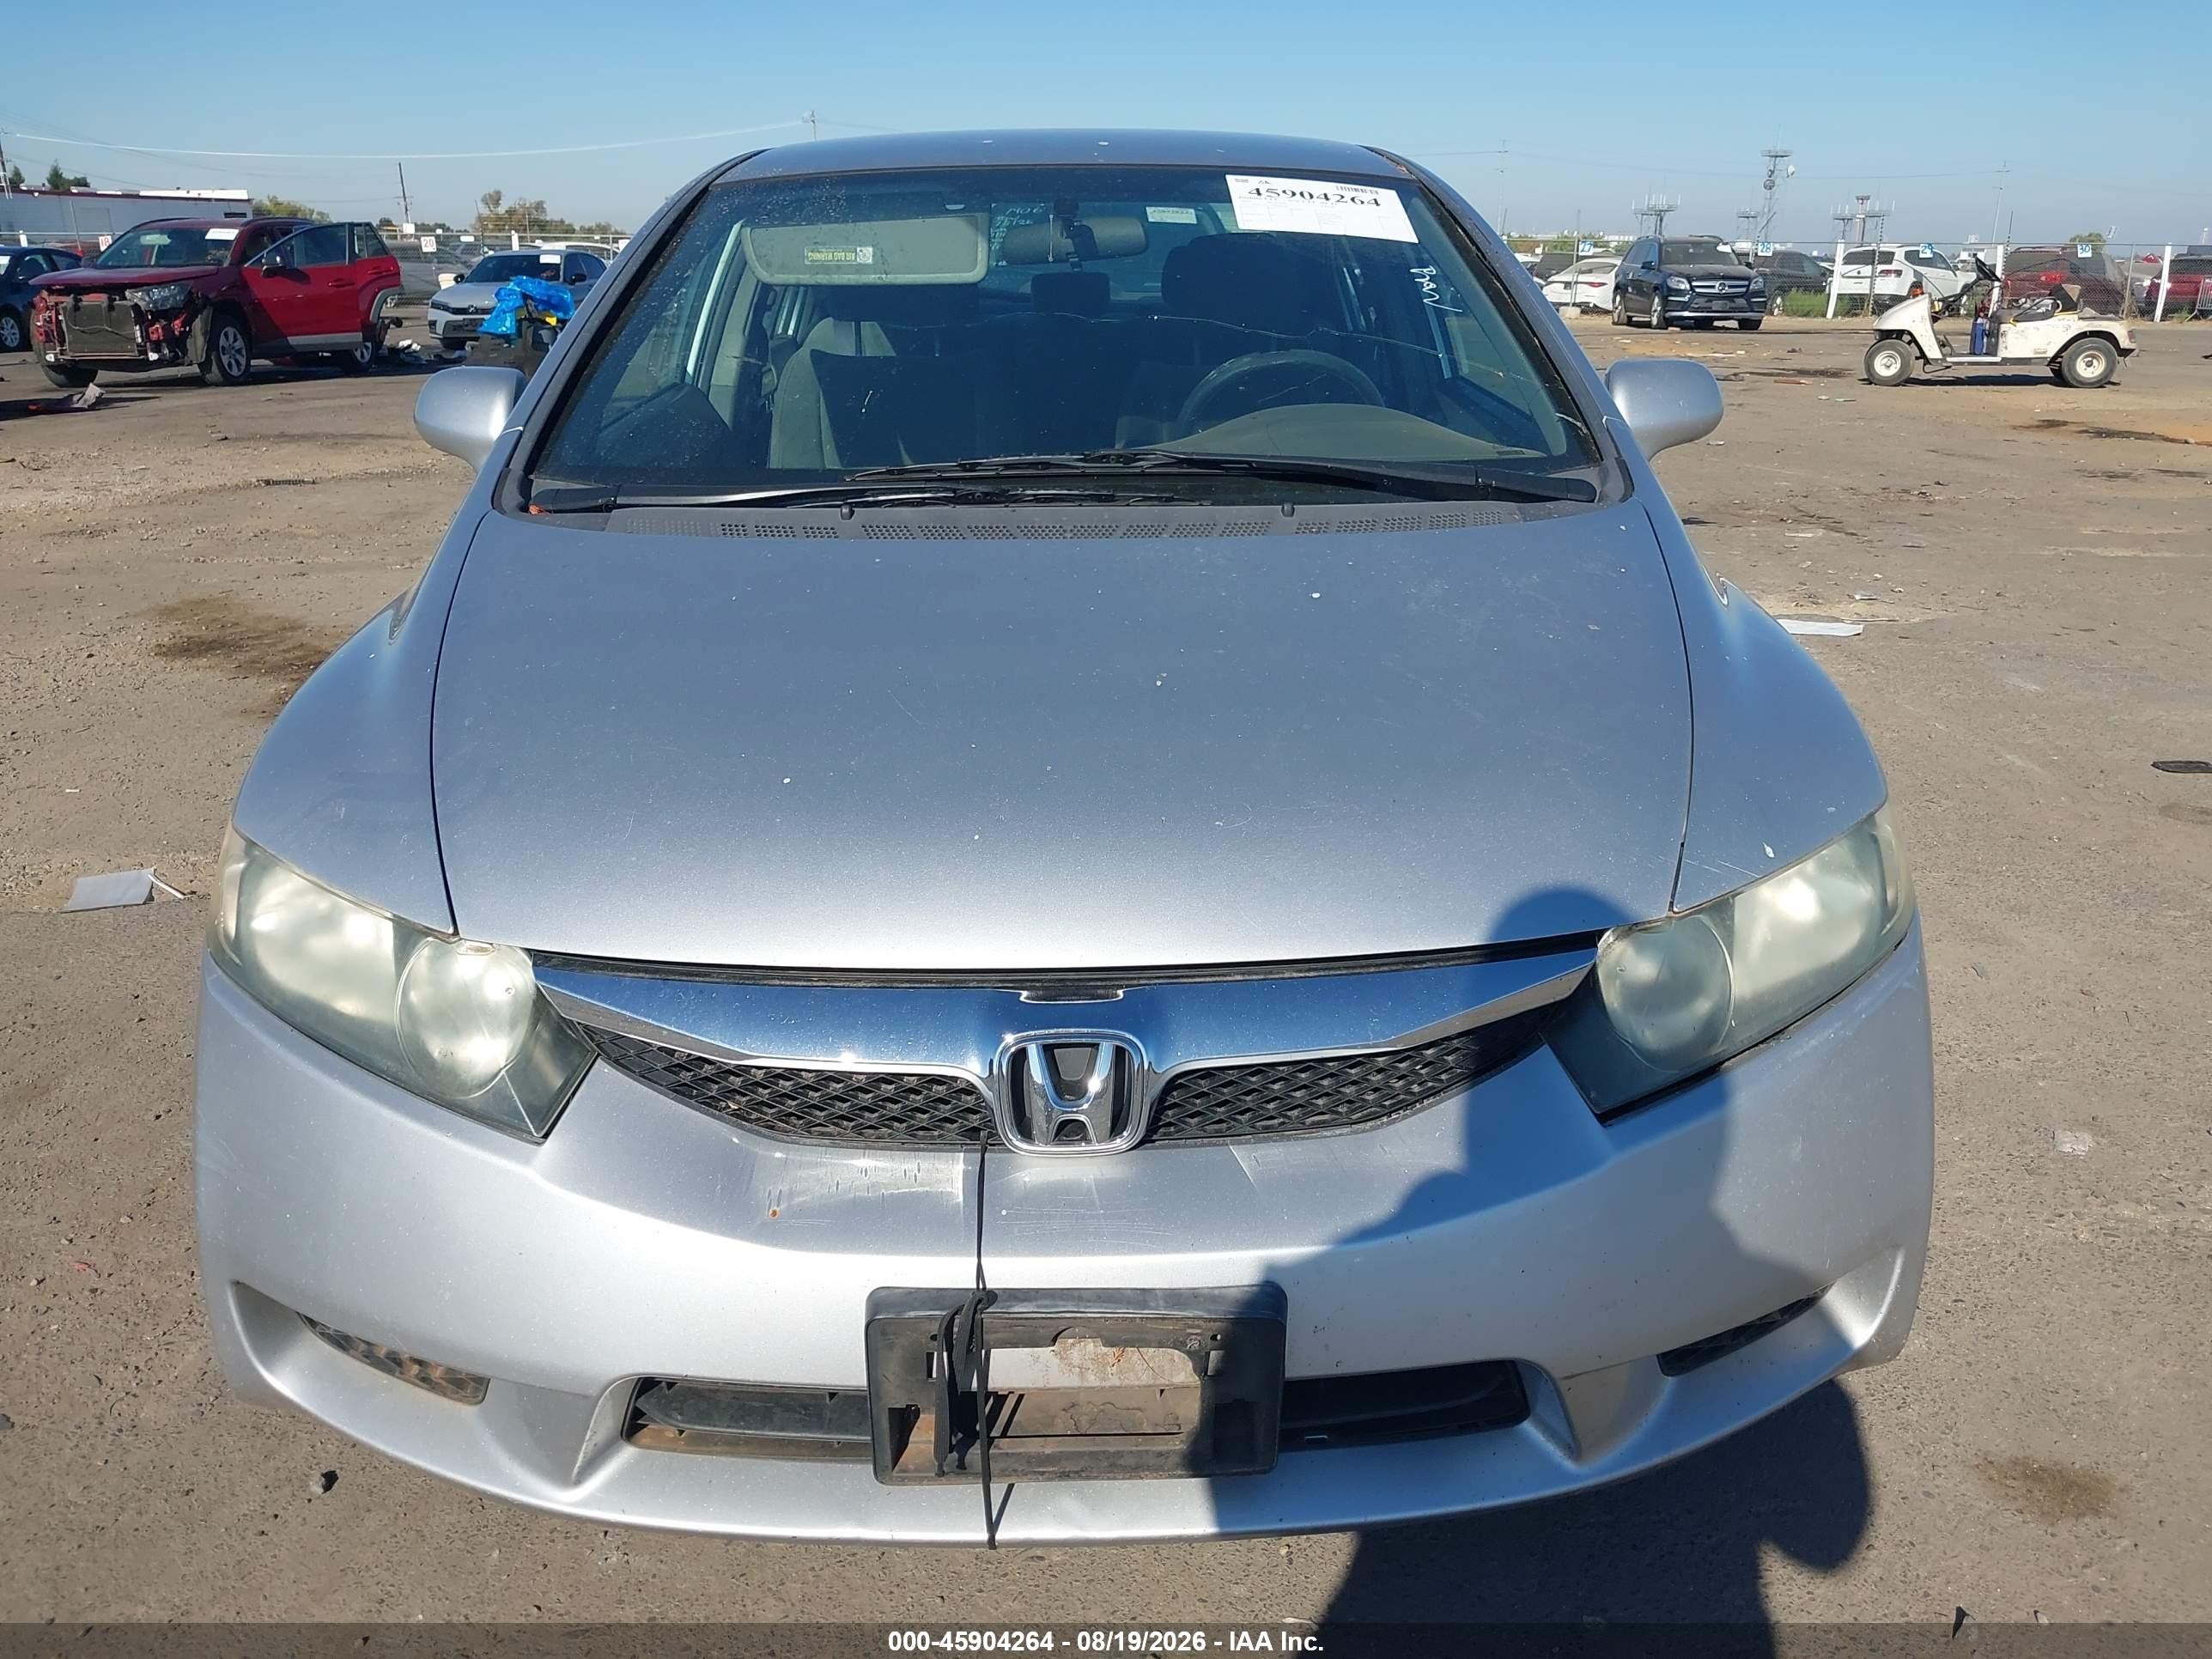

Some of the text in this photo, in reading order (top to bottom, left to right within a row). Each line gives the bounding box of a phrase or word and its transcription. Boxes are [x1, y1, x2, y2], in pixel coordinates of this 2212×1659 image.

[1248, 187, 1381, 206] 45904264
[423, 239, 434, 247] 20
[1760, 241, 1771, 252] 28
[1921, 242, 1934, 255] 29
[2079, 244, 2091, 255] 30
